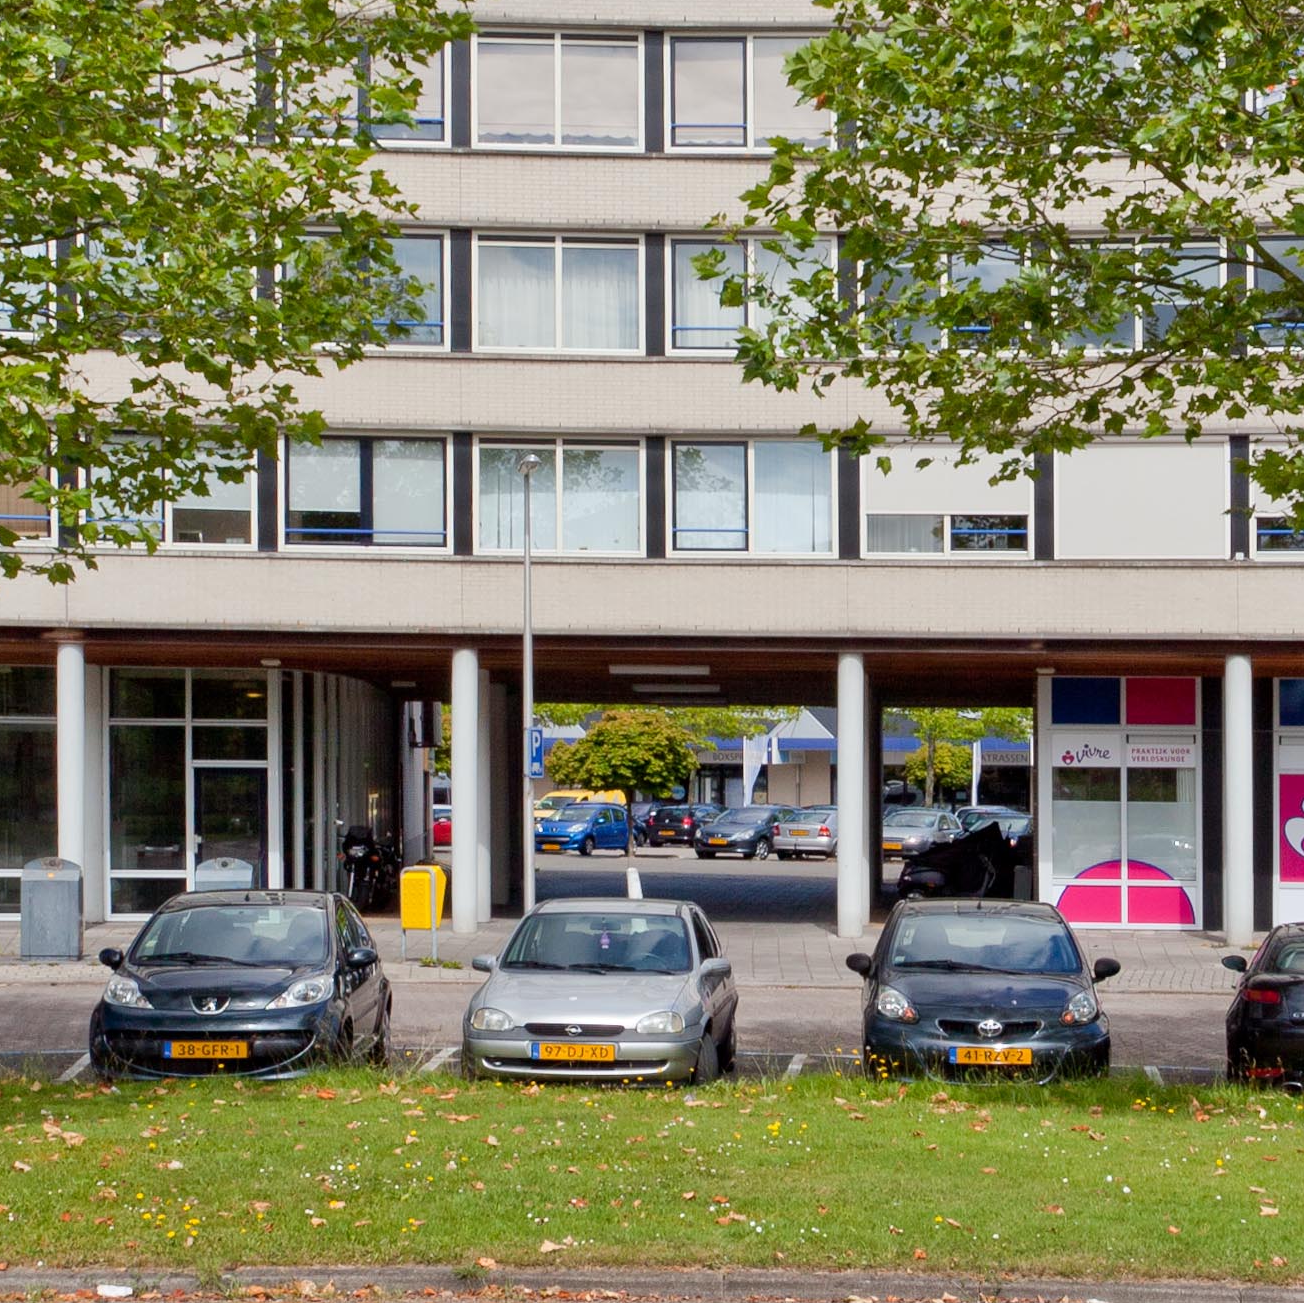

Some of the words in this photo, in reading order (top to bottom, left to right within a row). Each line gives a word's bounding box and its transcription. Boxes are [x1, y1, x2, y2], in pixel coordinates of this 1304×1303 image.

[532, 731, 541, 757] P
[1131, 747, 1167, 755] PRAKTIJK
[1170, 747, 1191, 755] VOOR
[1131, 755, 1186, 763] VERLOSKUNDE
[177, 1043, 240, 1057] 38-GFR-1
[544, 1045, 609, 1059] 97-DJ-XD
[963, 1050, 1024, 1062] 41-RZV-2
